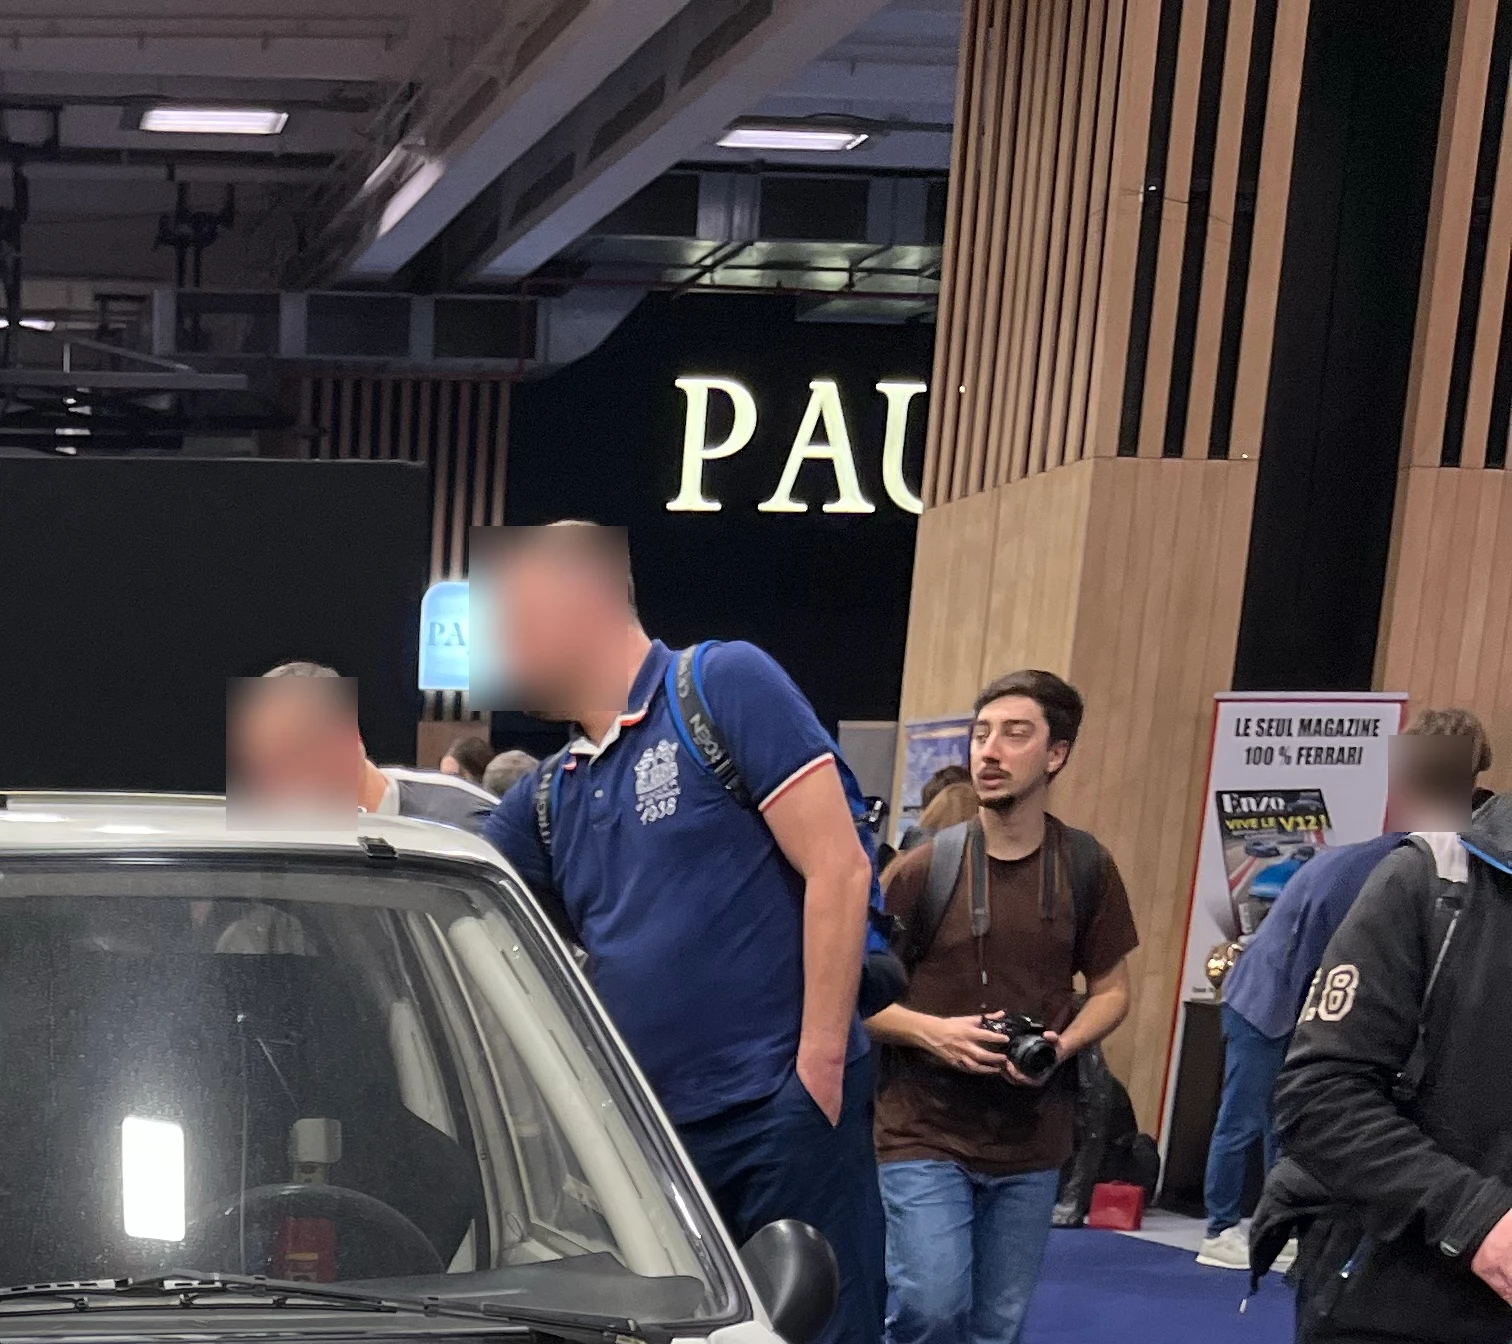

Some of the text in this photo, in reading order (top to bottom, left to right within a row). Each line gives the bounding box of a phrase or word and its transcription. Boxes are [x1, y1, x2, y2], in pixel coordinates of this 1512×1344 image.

[666, 377, 928, 515] PAU
[428, 622, 467, 647] PA
[1235, 717, 1381, 738] LE SEUL MAGAZINE
[1245, 745, 1364, 767] 100 % FERRARI
[1221, 792, 1286, 814] Enzo
